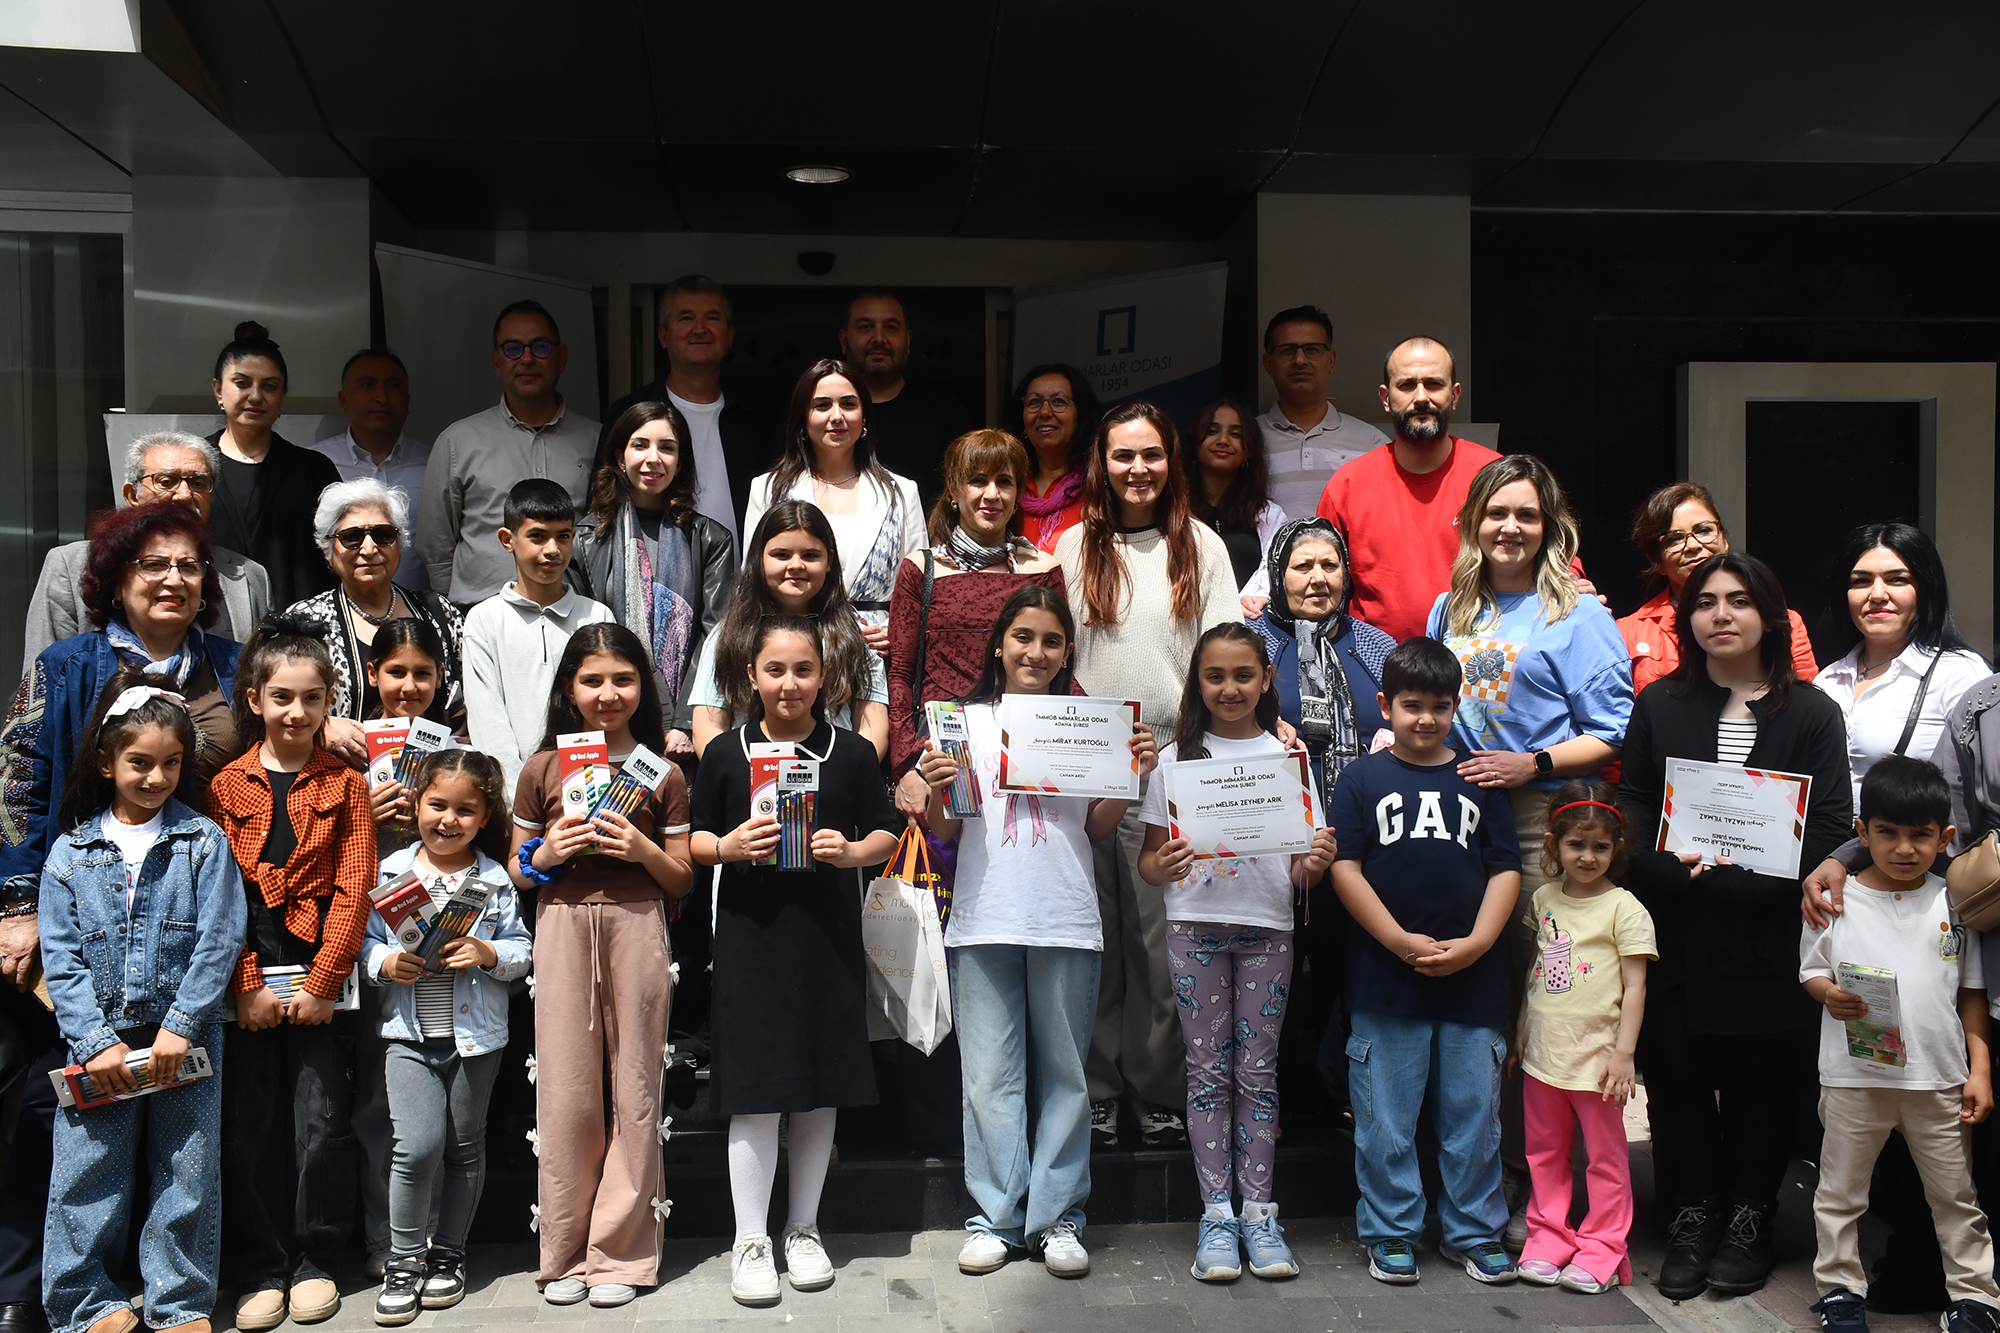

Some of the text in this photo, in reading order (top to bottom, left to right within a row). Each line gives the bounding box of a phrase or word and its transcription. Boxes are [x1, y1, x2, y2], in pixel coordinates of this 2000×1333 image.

[1077, 356, 1172, 378] MARLAR ODASI
[1102, 378, 1129, 392] 1954
[1074, 738, 1109, 746] KURTOĞLU
[1196, 803, 1215, 811] Sevgili
[1216, 800, 1239, 808] MELİSA
[1240, 798, 1265, 807] ZEYNEP
[1376, 791, 1480, 850] GAP
[1699, 813, 1766, 828] Sevgili HAZAL YILMAZ
[1711, 838, 1741, 850] MİMARLAR
[1743, 844, 1764, 853] TMMOB
[871, 893, 886, 911] &
[867, 912, 907, 920] detection
[864, 946, 897, 961] ating
[1242, 954, 1268, 967] Stitch
[866, 963, 918, 978] nfidence
[932, 960, 948, 972] Ge
[1211, 1011, 1229, 1032] Stitch
[1202, 1166, 1223, 1183] Stitch
